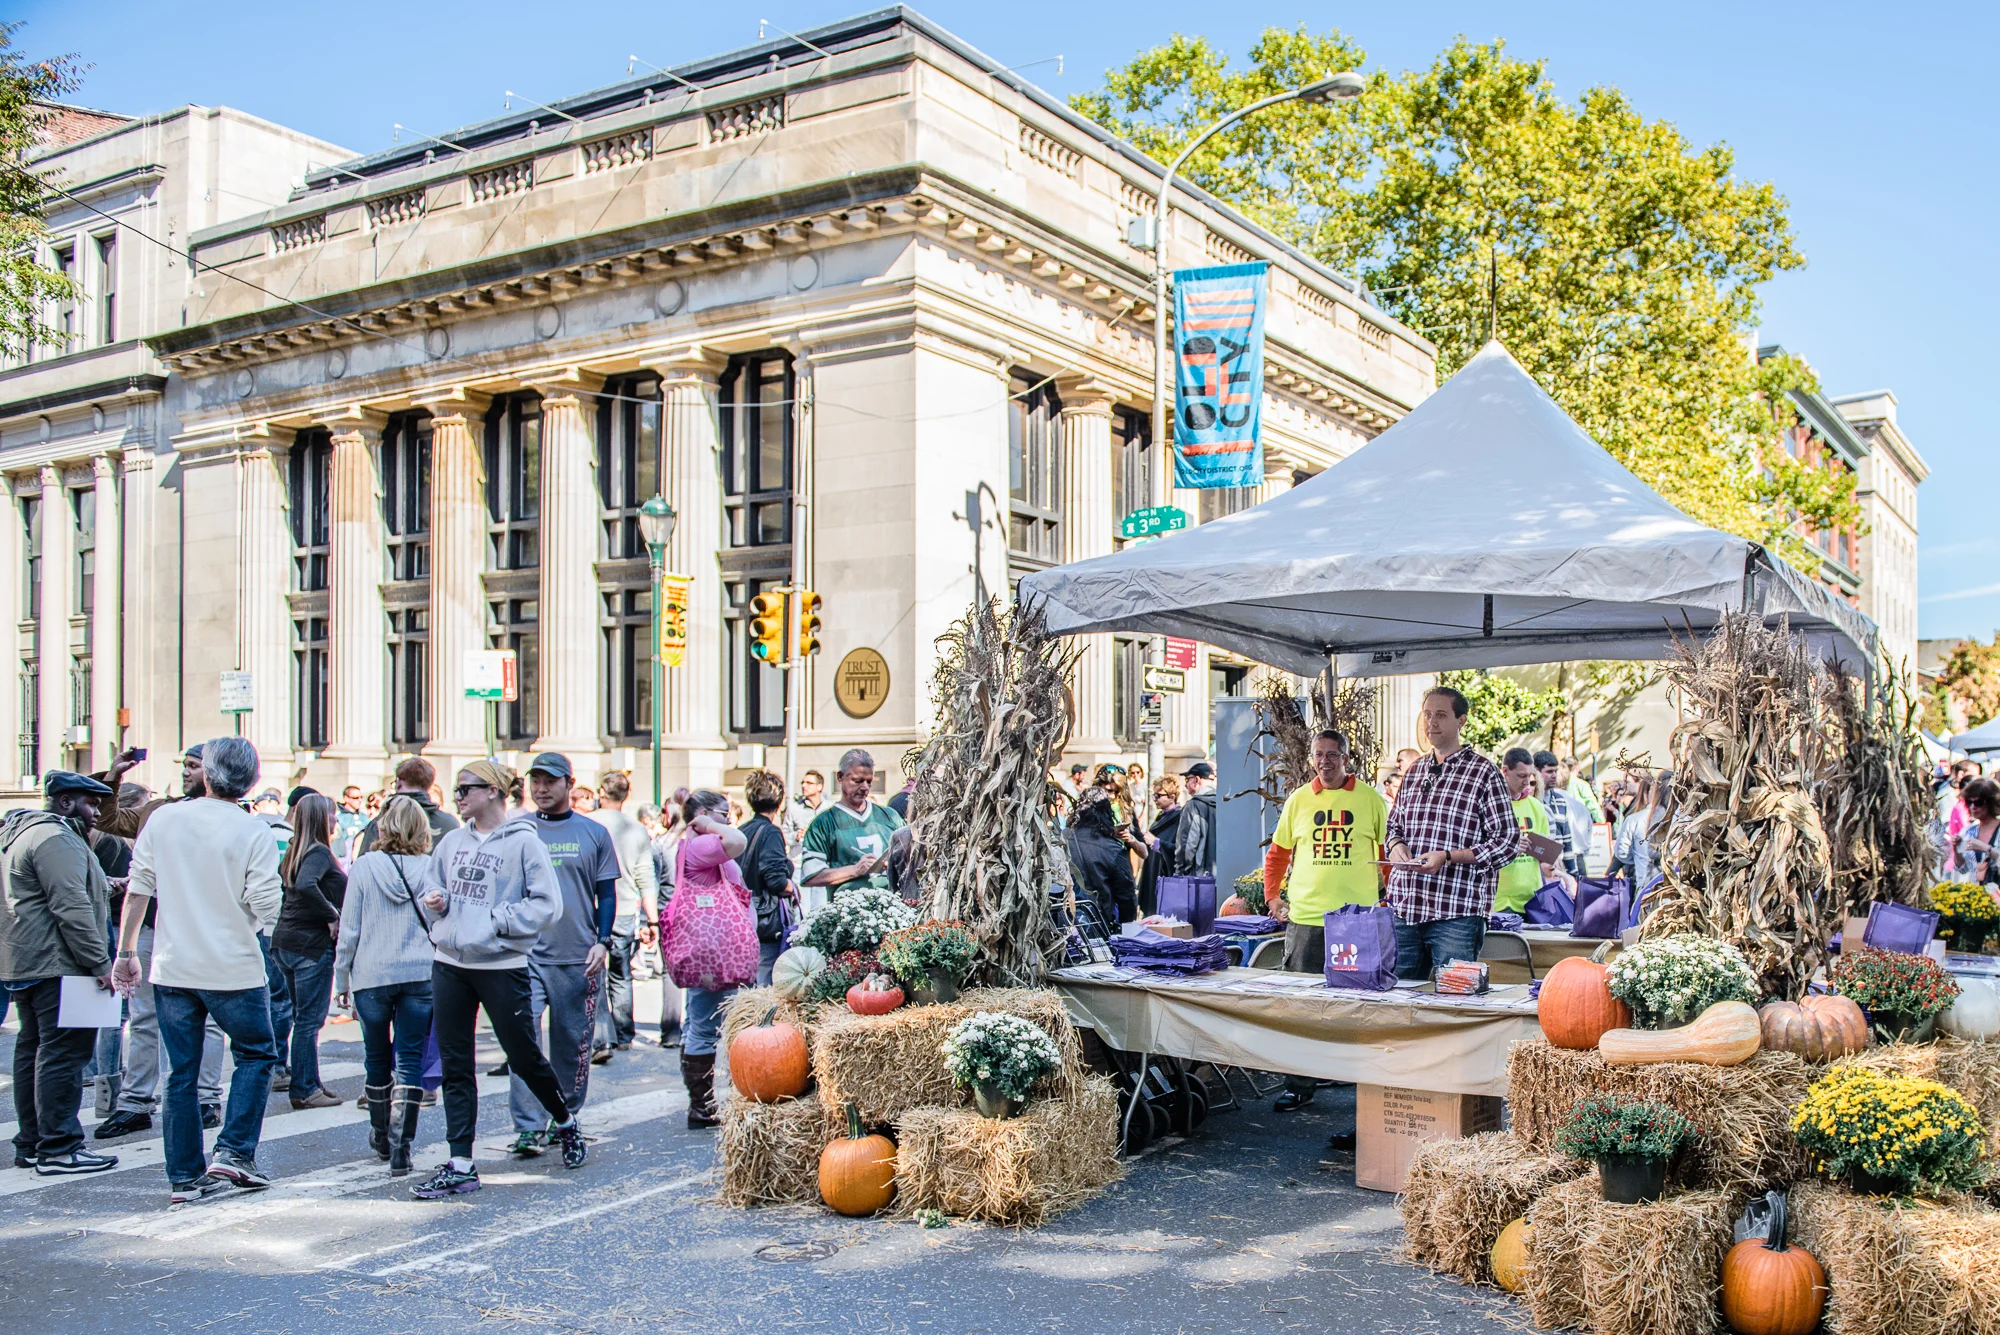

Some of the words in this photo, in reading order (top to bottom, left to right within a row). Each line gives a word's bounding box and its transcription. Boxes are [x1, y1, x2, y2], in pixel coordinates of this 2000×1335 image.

[1182, 336, 1217, 430] OLD
[1139, 517, 1161, 533] 3RD
[1169, 517, 1183, 529] ST
[845, 660, 881, 672] TRUST
[1157, 674, 1167, 684] ONE
[1170, 677, 1180, 686] WAY
[1314, 810, 1354, 826] OLD
[547, 842, 579, 852] ISHER
[1313, 844, 1352, 858] FEST
[451, 880, 488, 900] HAWKS
[1330, 943, 1358, 955] OLD
